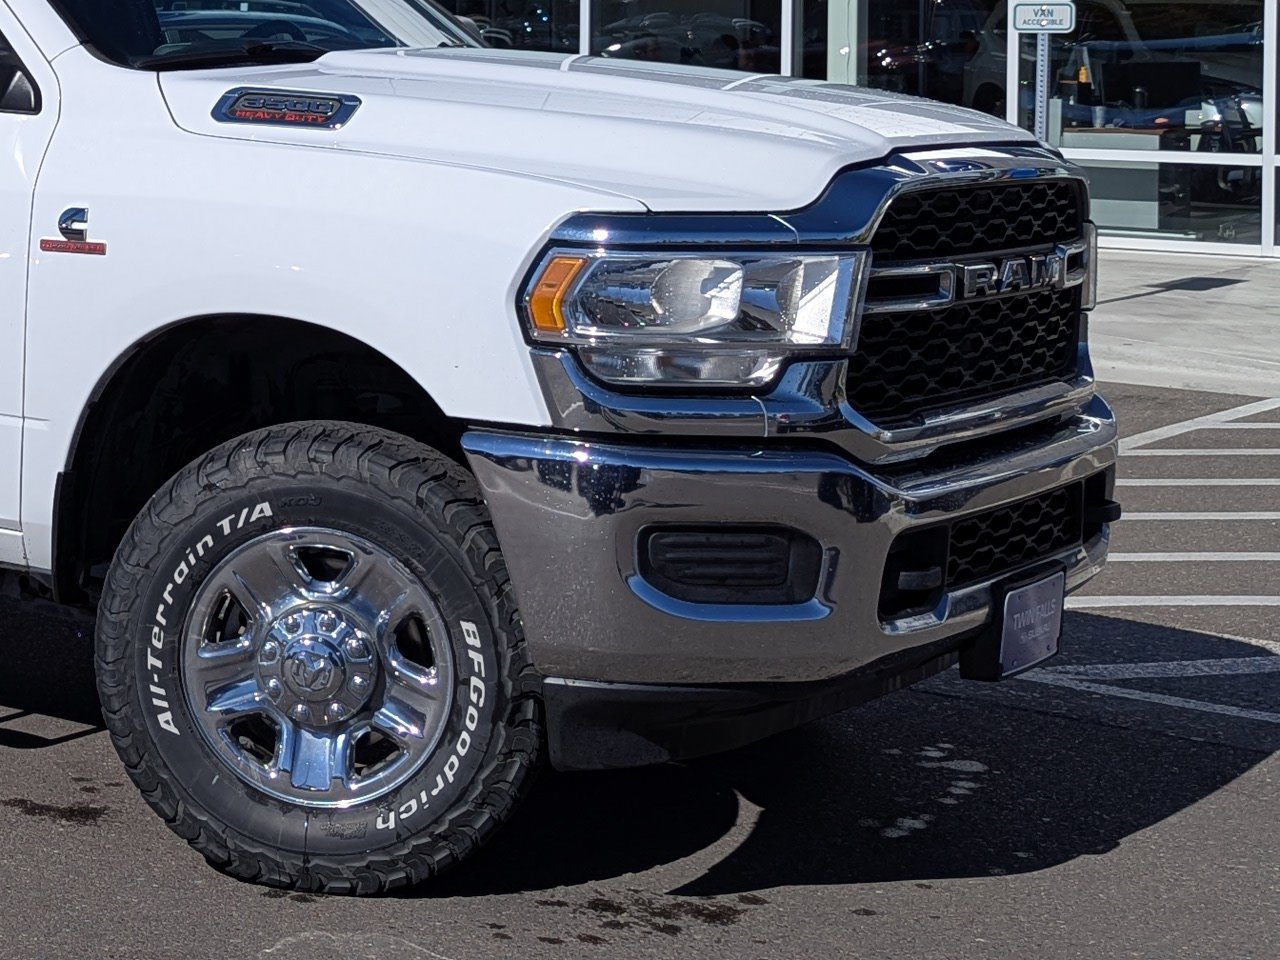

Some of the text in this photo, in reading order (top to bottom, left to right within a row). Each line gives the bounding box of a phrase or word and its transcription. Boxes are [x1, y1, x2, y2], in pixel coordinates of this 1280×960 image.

[1032, 8, 1054, 18] VAN
[235, 110, 326, 123] HEAVY DUTY
[240, 97, 334, 115] 3500
[957, 254, 1062, 298] RAM
[147, 533, 215, 737] All-Terrain
[216, 501, 274, 536] T/A
[376, 620, 486, 830] BFGoodrich
